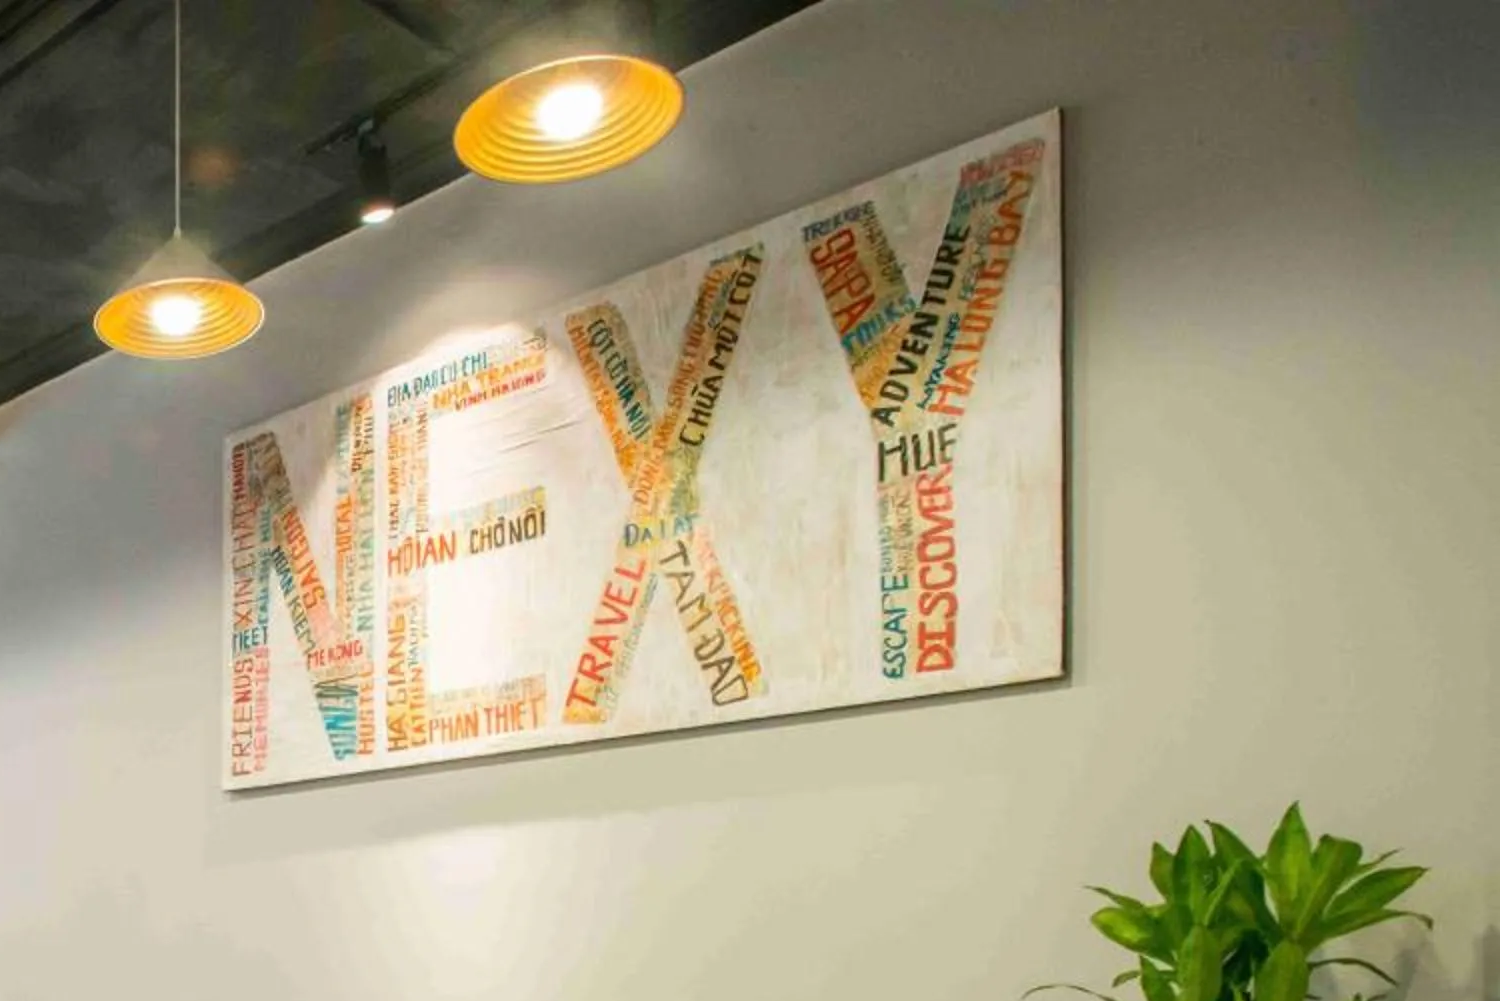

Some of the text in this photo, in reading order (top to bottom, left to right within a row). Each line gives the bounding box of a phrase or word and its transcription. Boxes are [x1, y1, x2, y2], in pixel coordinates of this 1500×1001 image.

[987, 170, 1034, 246] BAY
[810, 227, 876, 336] SAPA
[871, 222, 971, 427] ADVENTURE
[233, 578, 253, 628] XIN
[659, 540, 712, 632] TAM
[916, 464, 959, 673] DISCOVER
[233, 626, 268, 653] MEET
[566, 559, 647, 708] TRAVEL
[880, 574, 909, 680] ESCAPE
[232, 657, 253, 776] FRIENDS
[429, 703, 479, 744] PHAN
